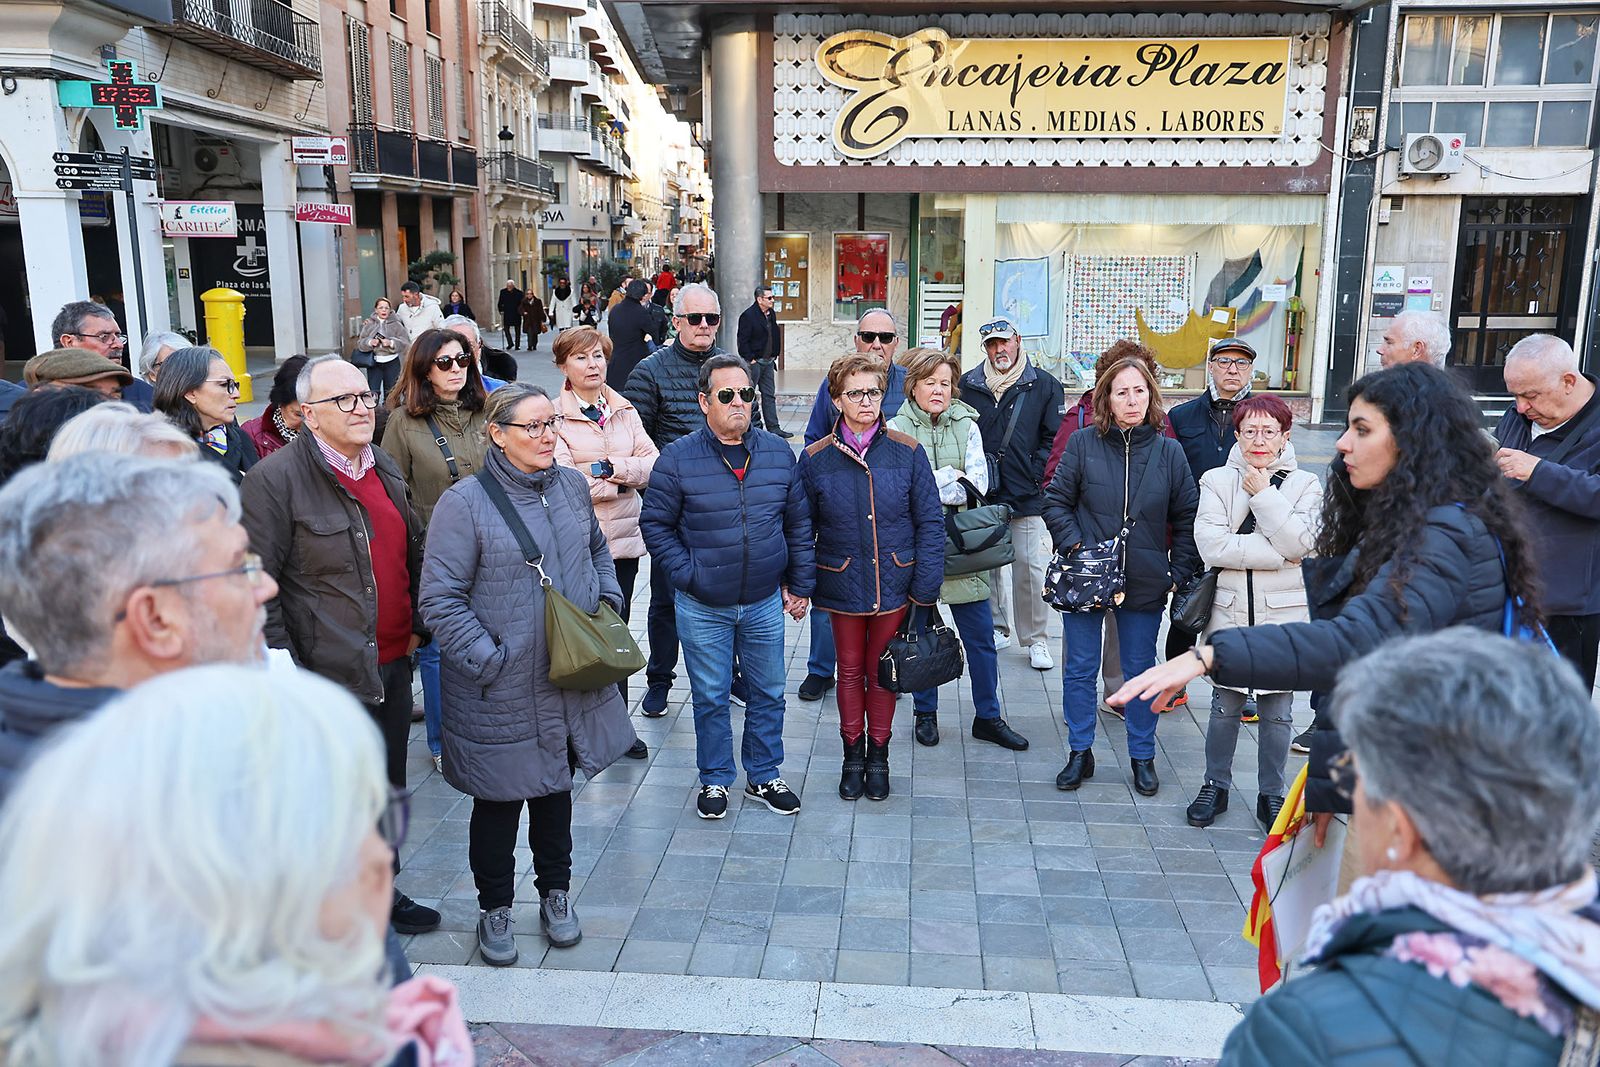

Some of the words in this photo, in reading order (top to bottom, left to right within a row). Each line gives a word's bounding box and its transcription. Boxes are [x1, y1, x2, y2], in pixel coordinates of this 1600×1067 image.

[98, 87, 151, 103] 17:52
[824, 38, 1122, 150] Encajeria
[1126, 42, 1286, 88] Plaza
[947, 110, 1022, 132] LANAS
[1047, 110, 1136, 132] MEDIAS
[1161, 109, 1265, 132] LABORES
[190, 204, 228, 215] Estética
[297, 202, 349, 217] PELUQUERIA
[215, 281, 239, 289] Plaza
[240, 281, 250, 289] de
[251, 281, 265, 289] las
